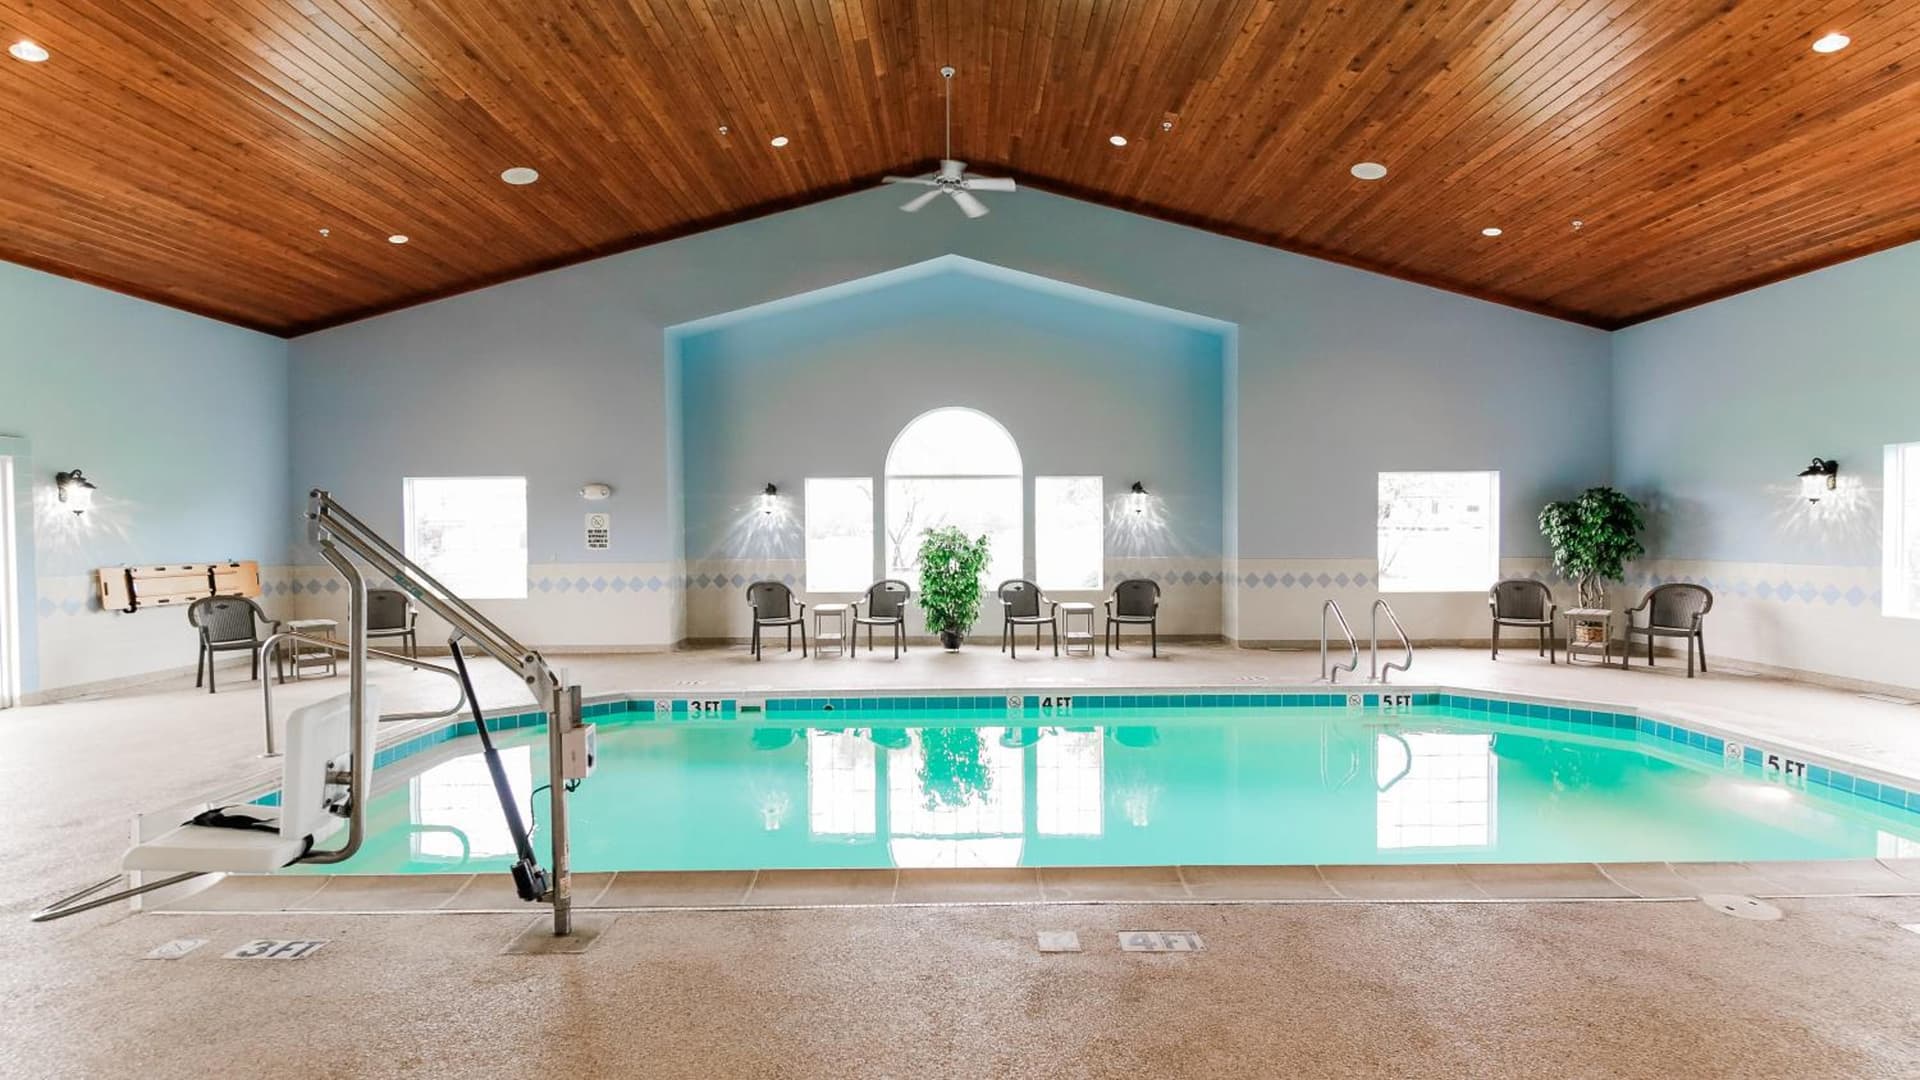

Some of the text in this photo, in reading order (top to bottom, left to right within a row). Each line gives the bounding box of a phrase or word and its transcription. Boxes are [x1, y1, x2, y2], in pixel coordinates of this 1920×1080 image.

[1042, 697, 1071, 708] 4 FT
[1396, 695, 1411, 706] FT
[704, 701, 720, 712] FT
[1785, 759, 1805, 777] FT
[236, 940, 324, 957] 3FT
